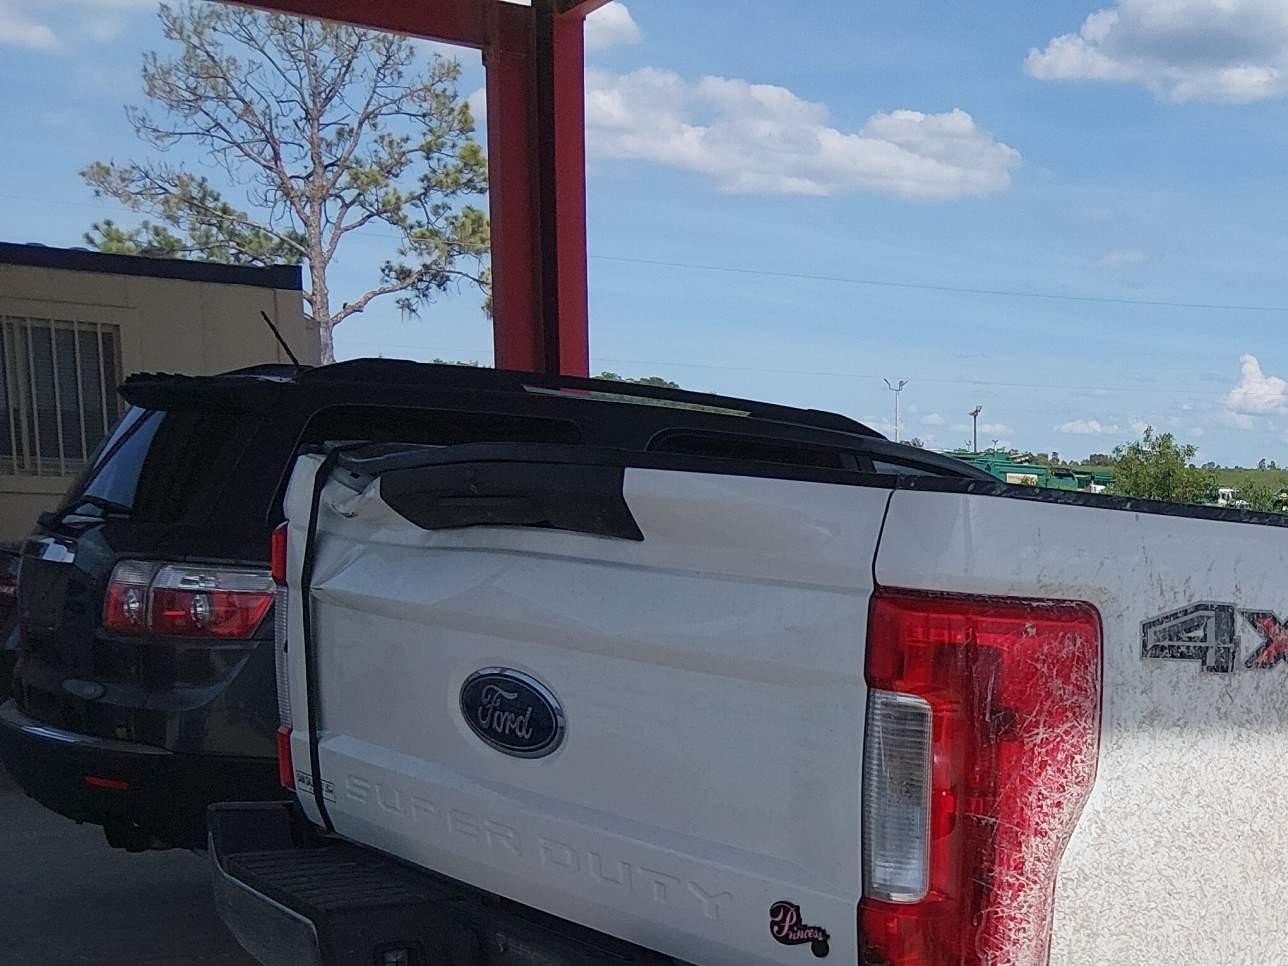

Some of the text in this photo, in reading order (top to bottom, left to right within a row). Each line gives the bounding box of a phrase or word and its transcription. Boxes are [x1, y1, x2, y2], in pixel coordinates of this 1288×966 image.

[478, 684, 533, 740] Ford
[346, 773, 733, 920] SUPER DUTY
[770, 903, 824, 940] Princess
